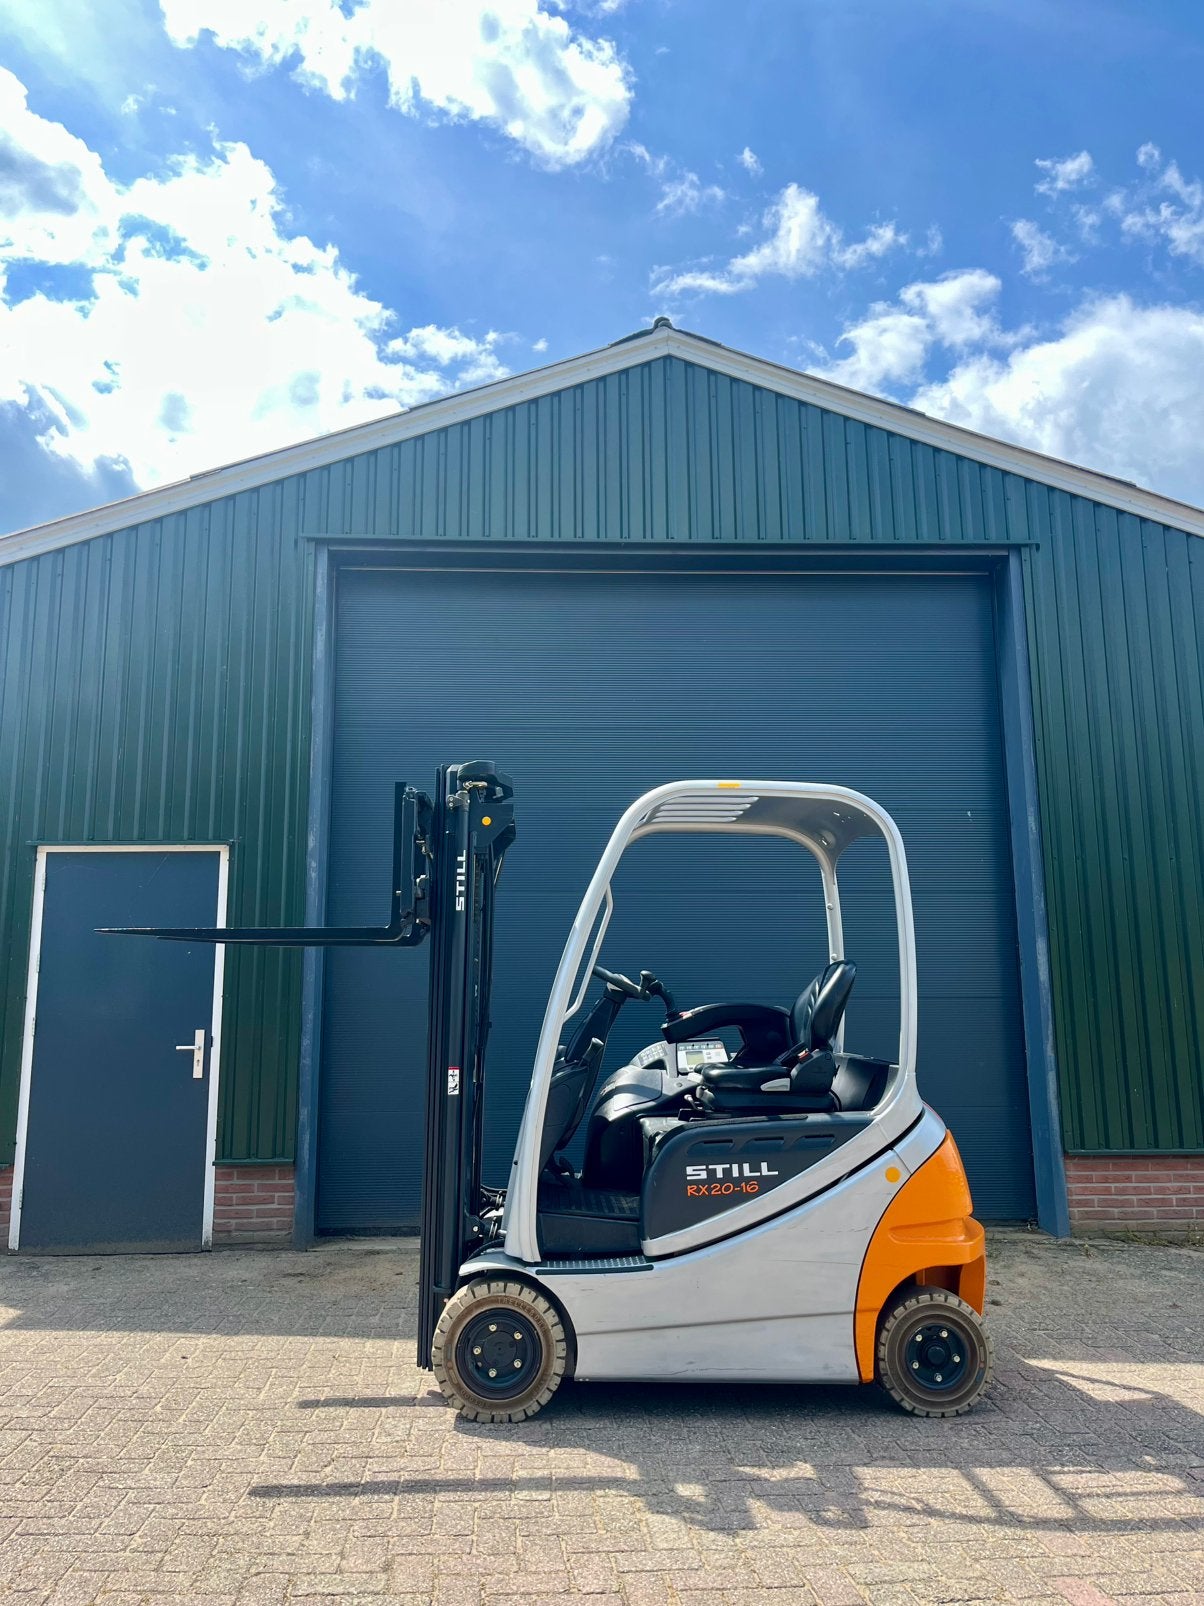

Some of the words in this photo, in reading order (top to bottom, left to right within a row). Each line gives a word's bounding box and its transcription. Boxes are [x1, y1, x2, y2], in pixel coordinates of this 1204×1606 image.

[456, 850, 466, 911] STILL
[686, 1162, 779, 1180] STILL
[687, 1181, 759, 1197] RX20-16
